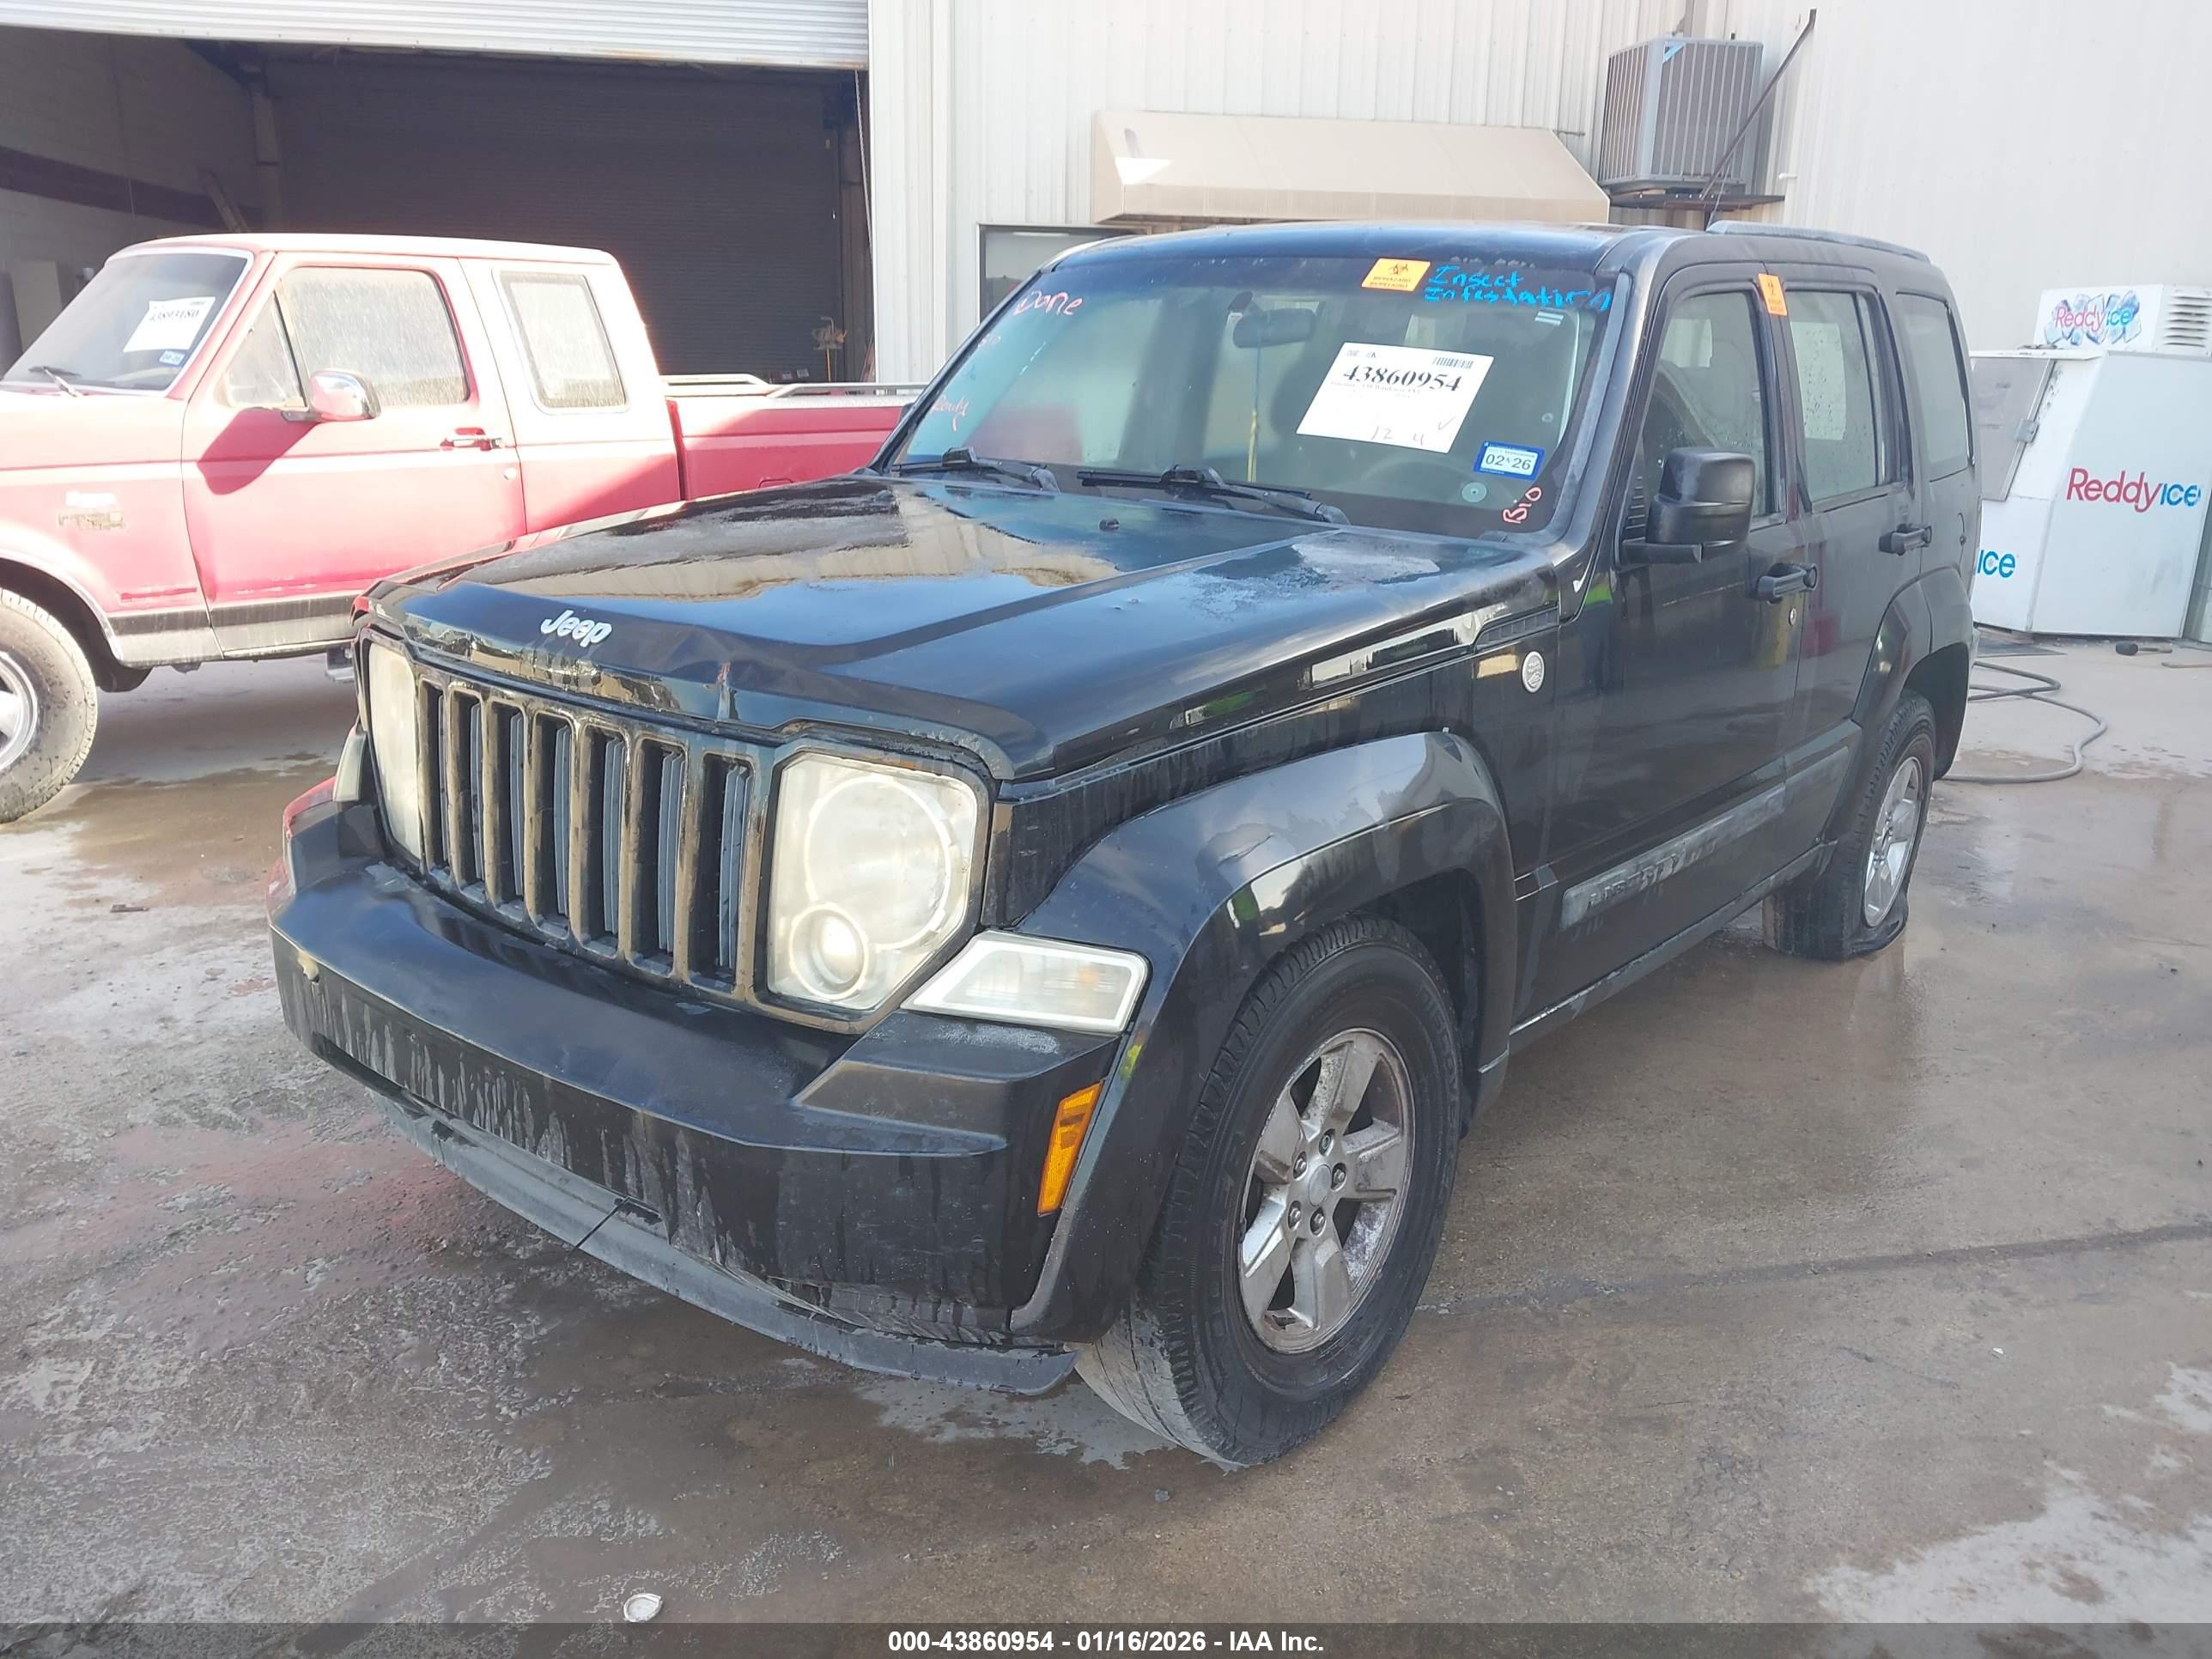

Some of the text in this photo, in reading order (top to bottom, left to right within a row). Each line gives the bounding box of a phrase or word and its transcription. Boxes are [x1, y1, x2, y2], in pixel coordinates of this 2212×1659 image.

[1428, 265, 1524, 288] Insect
[1013, 290, 1084, 316] Done
[1342, 363, 1463, 392] 43860954
[540, 609, 612, 648] Jeep
